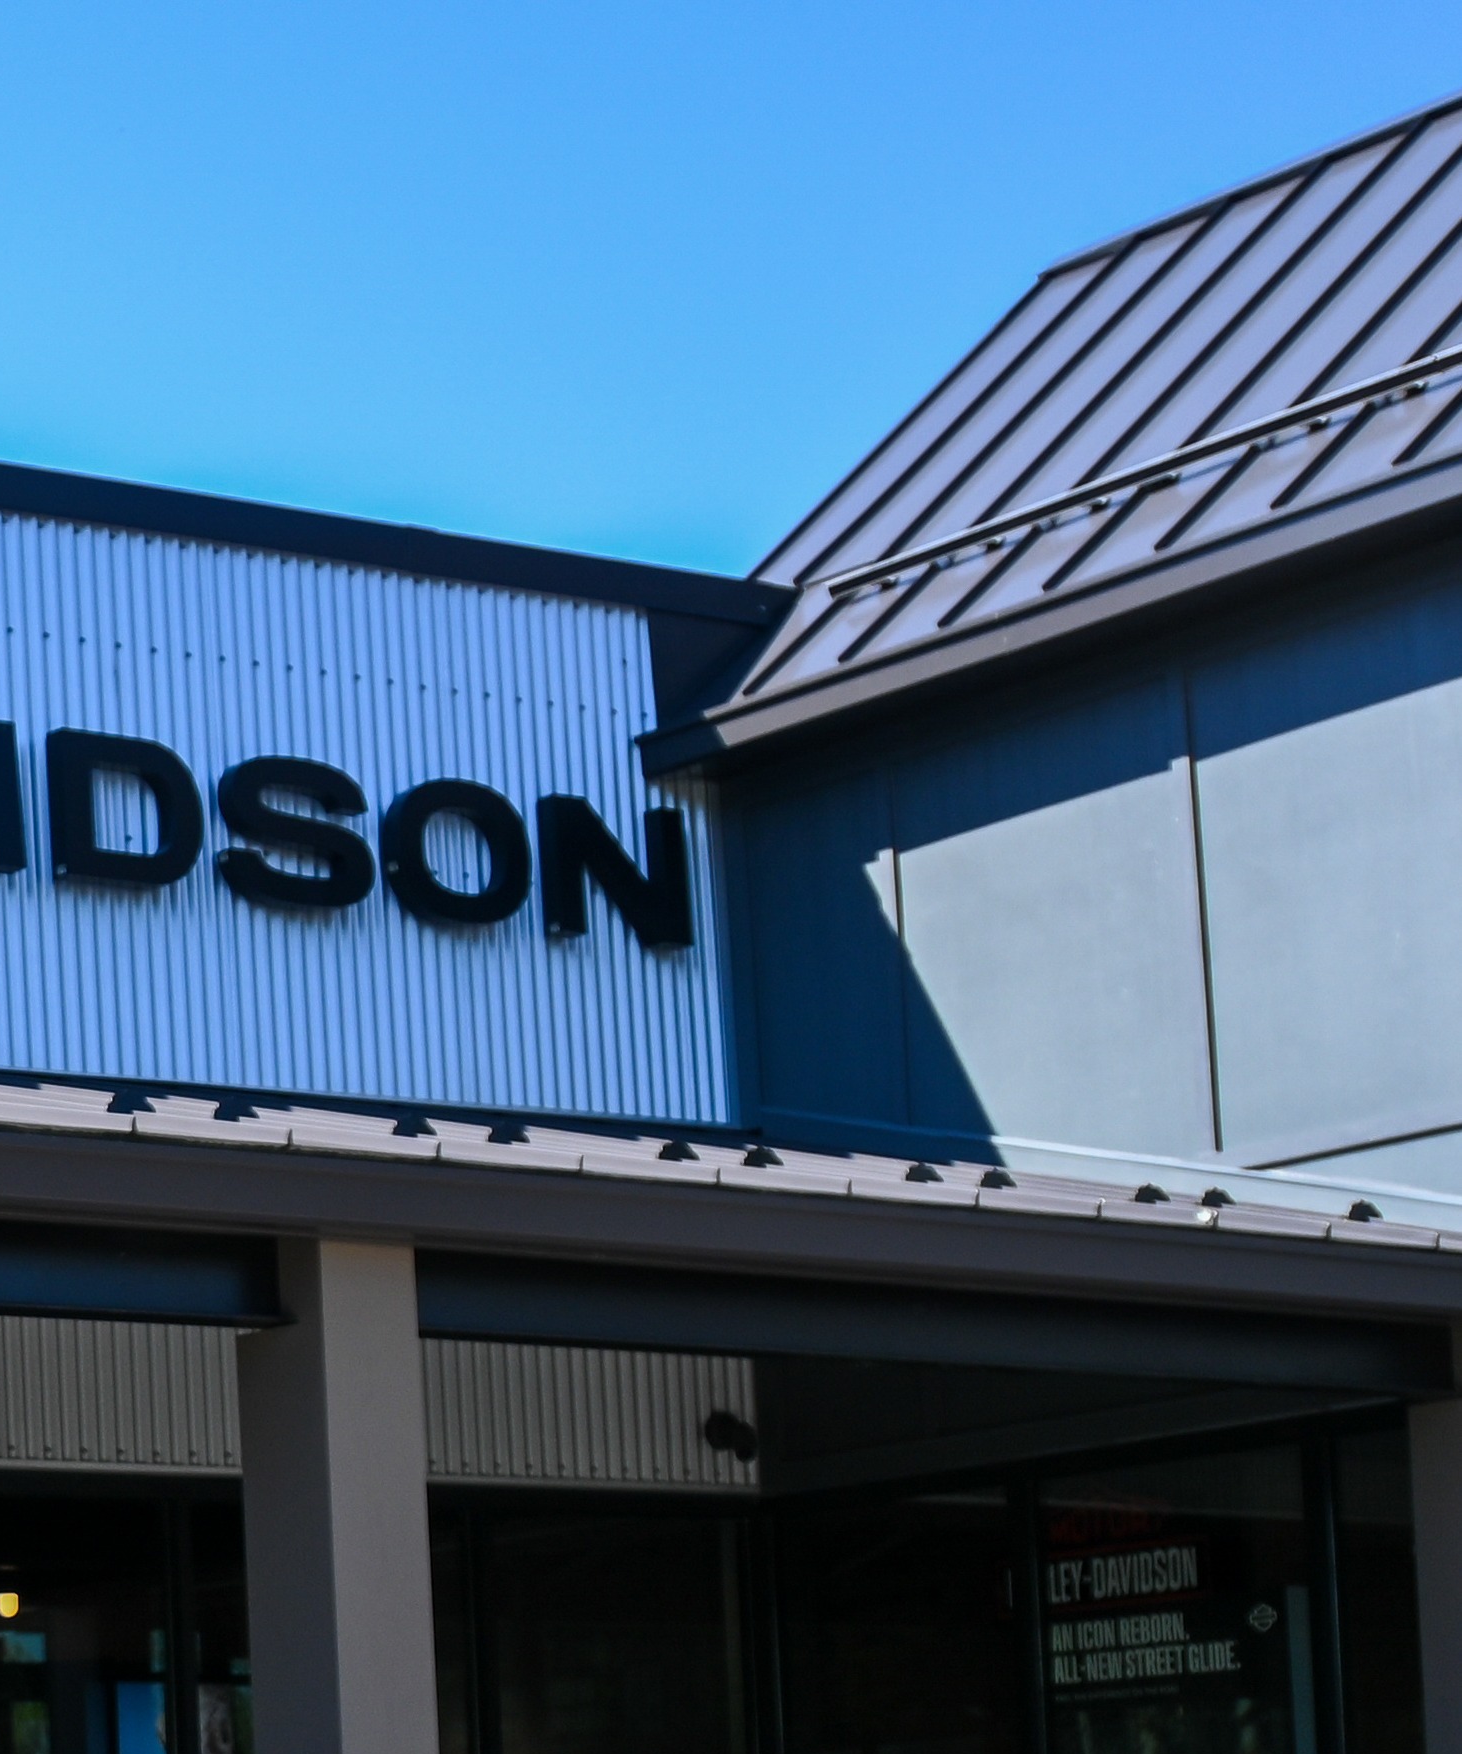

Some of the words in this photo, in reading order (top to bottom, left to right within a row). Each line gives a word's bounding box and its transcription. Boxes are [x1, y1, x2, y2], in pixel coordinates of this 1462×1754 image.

[1047, 1546, 1198, 1604] LEY-DAVIDSON
[1052, 1622, 1073, 1652] AN
[1077, 1617, 1115, 1649] ICON
[1119, 1612, 1190, 1646] REBORN.
[1054, 1652, 1123, 1684] ALL-NEW
[1126, 1645, 1185, 1679] STREET
[1187, 1640, 1241, 1675] GLIDE.
